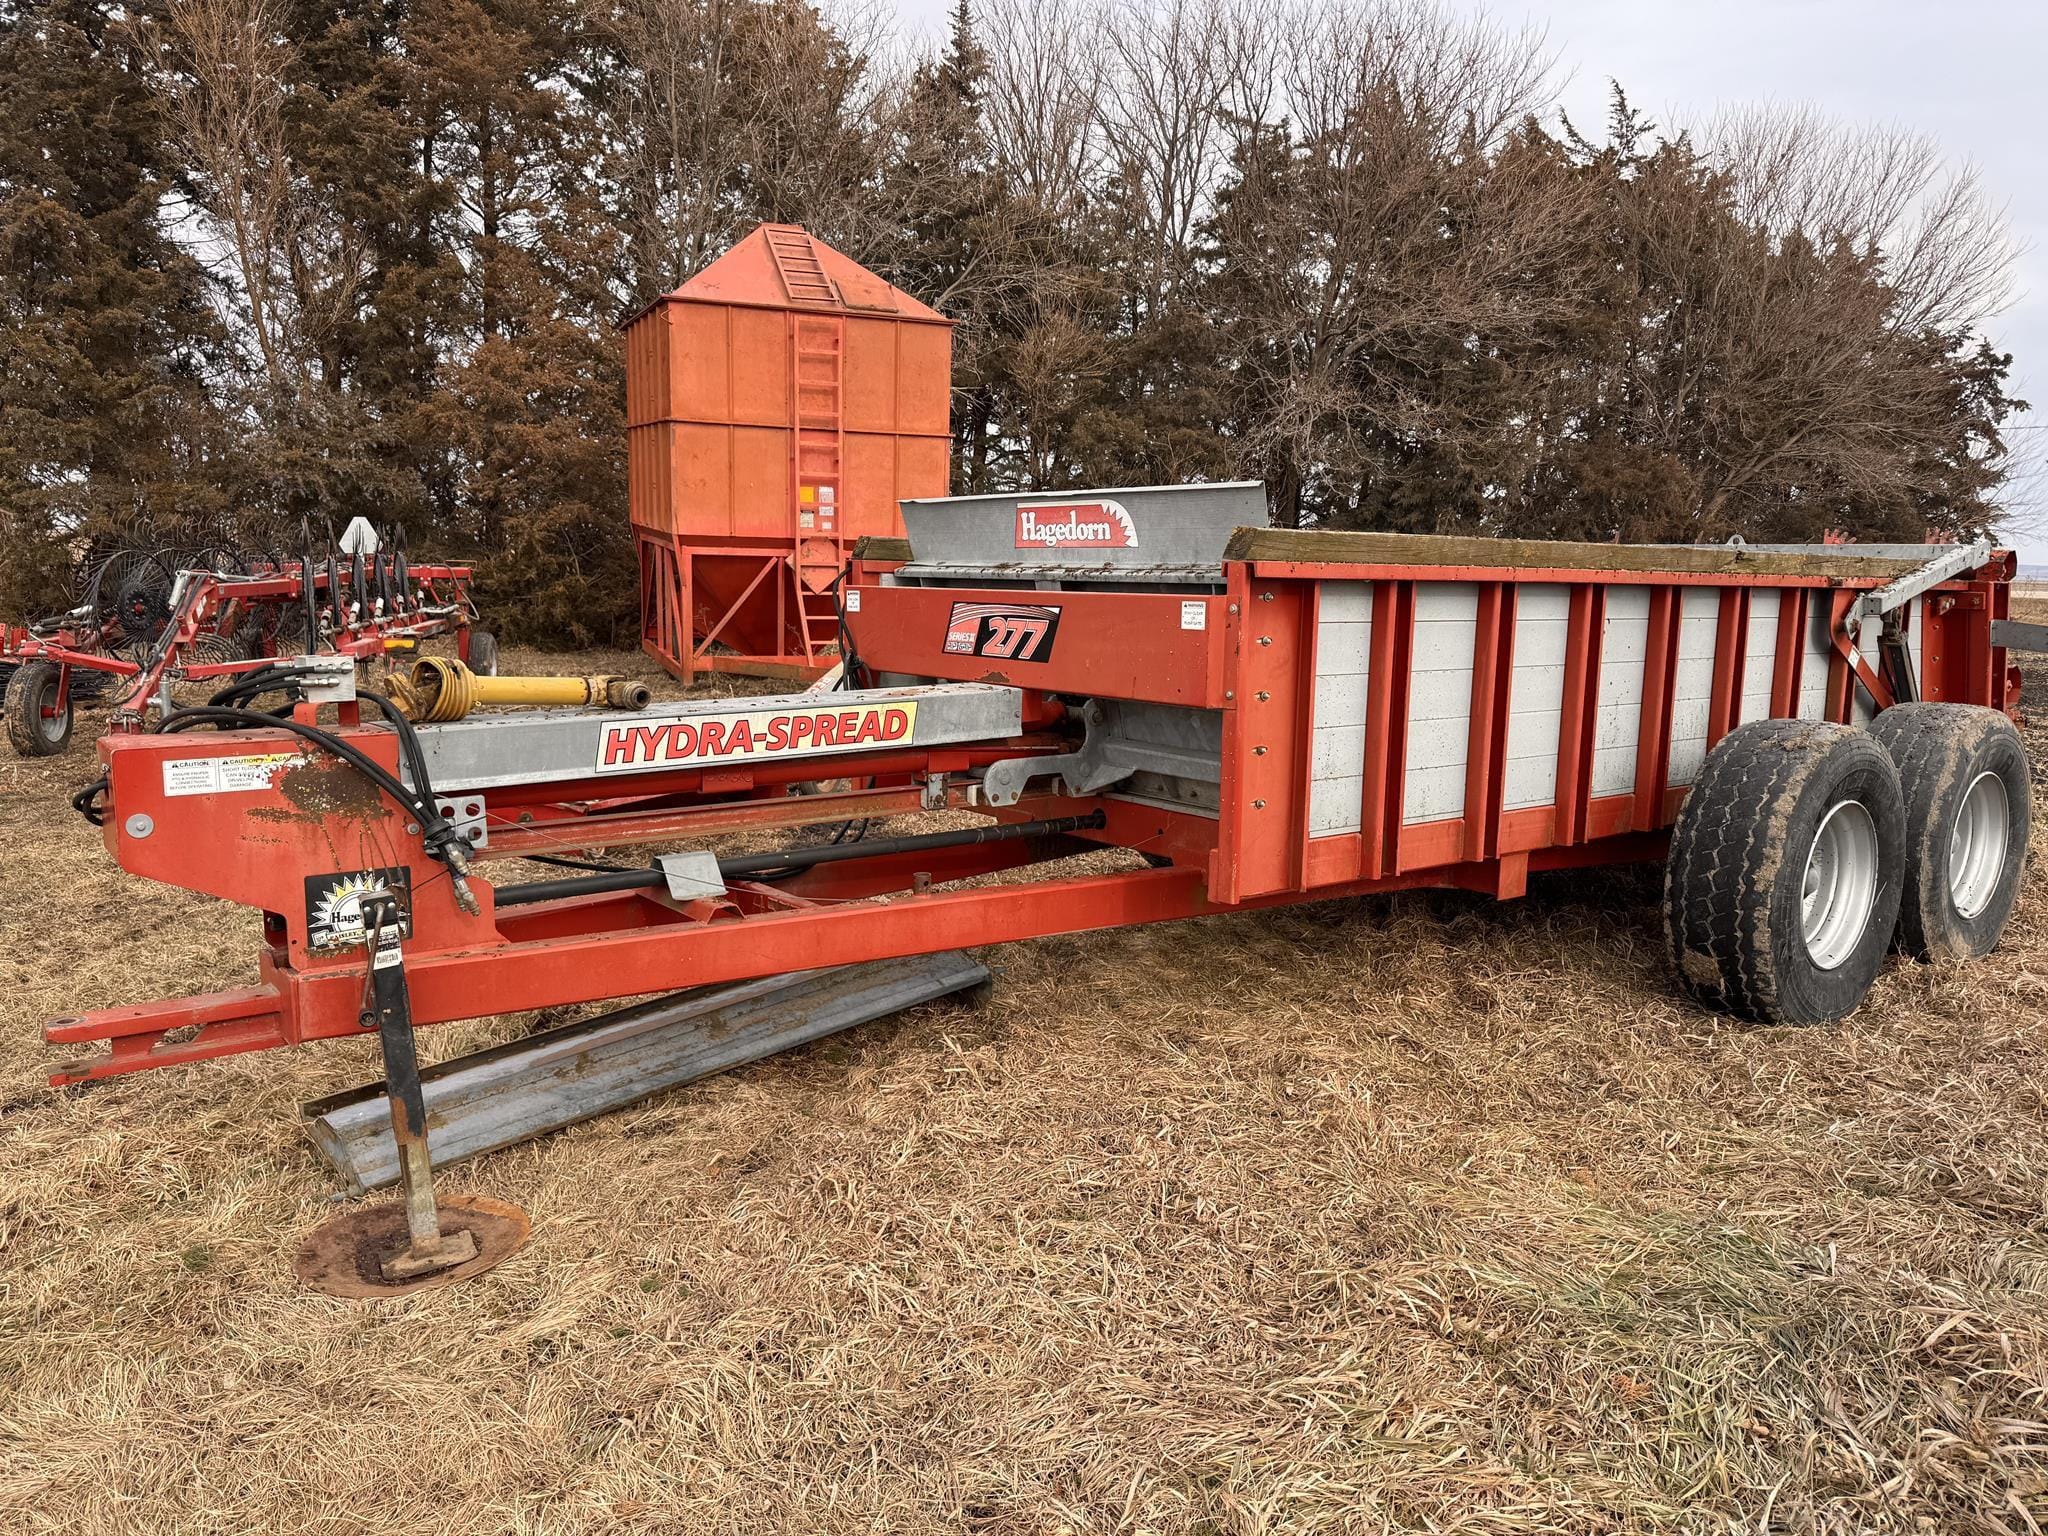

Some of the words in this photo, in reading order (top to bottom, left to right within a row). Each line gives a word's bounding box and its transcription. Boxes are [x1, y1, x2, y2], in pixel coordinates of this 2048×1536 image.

[1020, 510, 1112, 546] Hagedorn
[948, 631, 970, 642] SERIES
[981, 616, 1050, 660] 277
[604, 709, 908, 765] HYDRA-SPREAD
[331, 911, 360, 924] Hage
